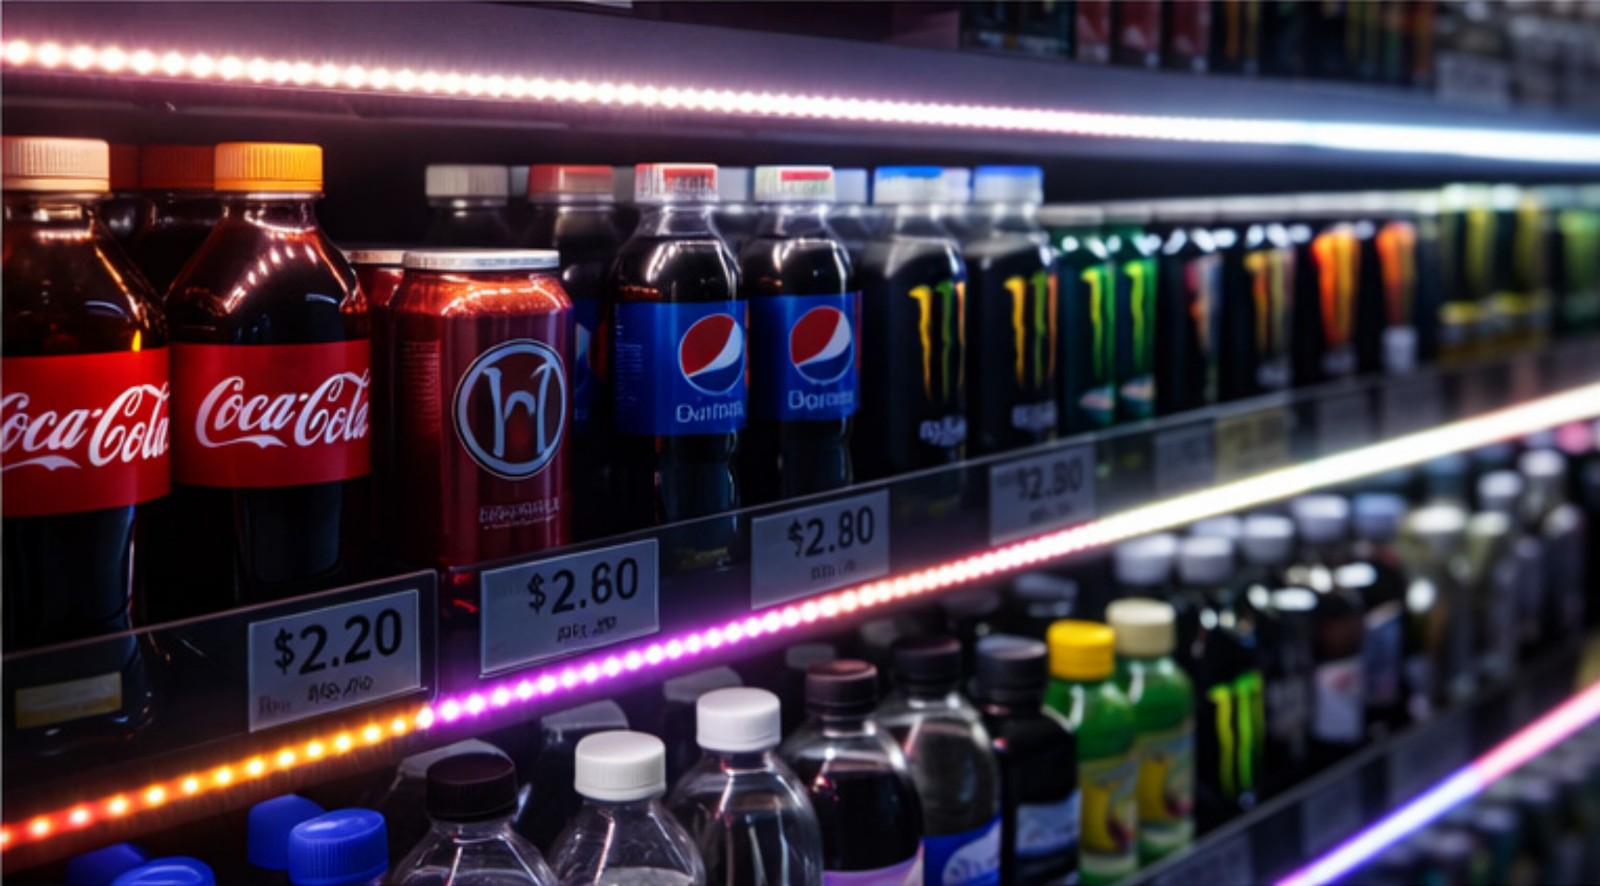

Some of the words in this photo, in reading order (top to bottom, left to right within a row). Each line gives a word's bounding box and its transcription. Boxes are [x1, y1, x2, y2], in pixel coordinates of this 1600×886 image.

[195, 368, 368, 449] Coca-Cola
[787, 506, 874, 558] $2.80
[273, 608, 402, 676] $2.20
